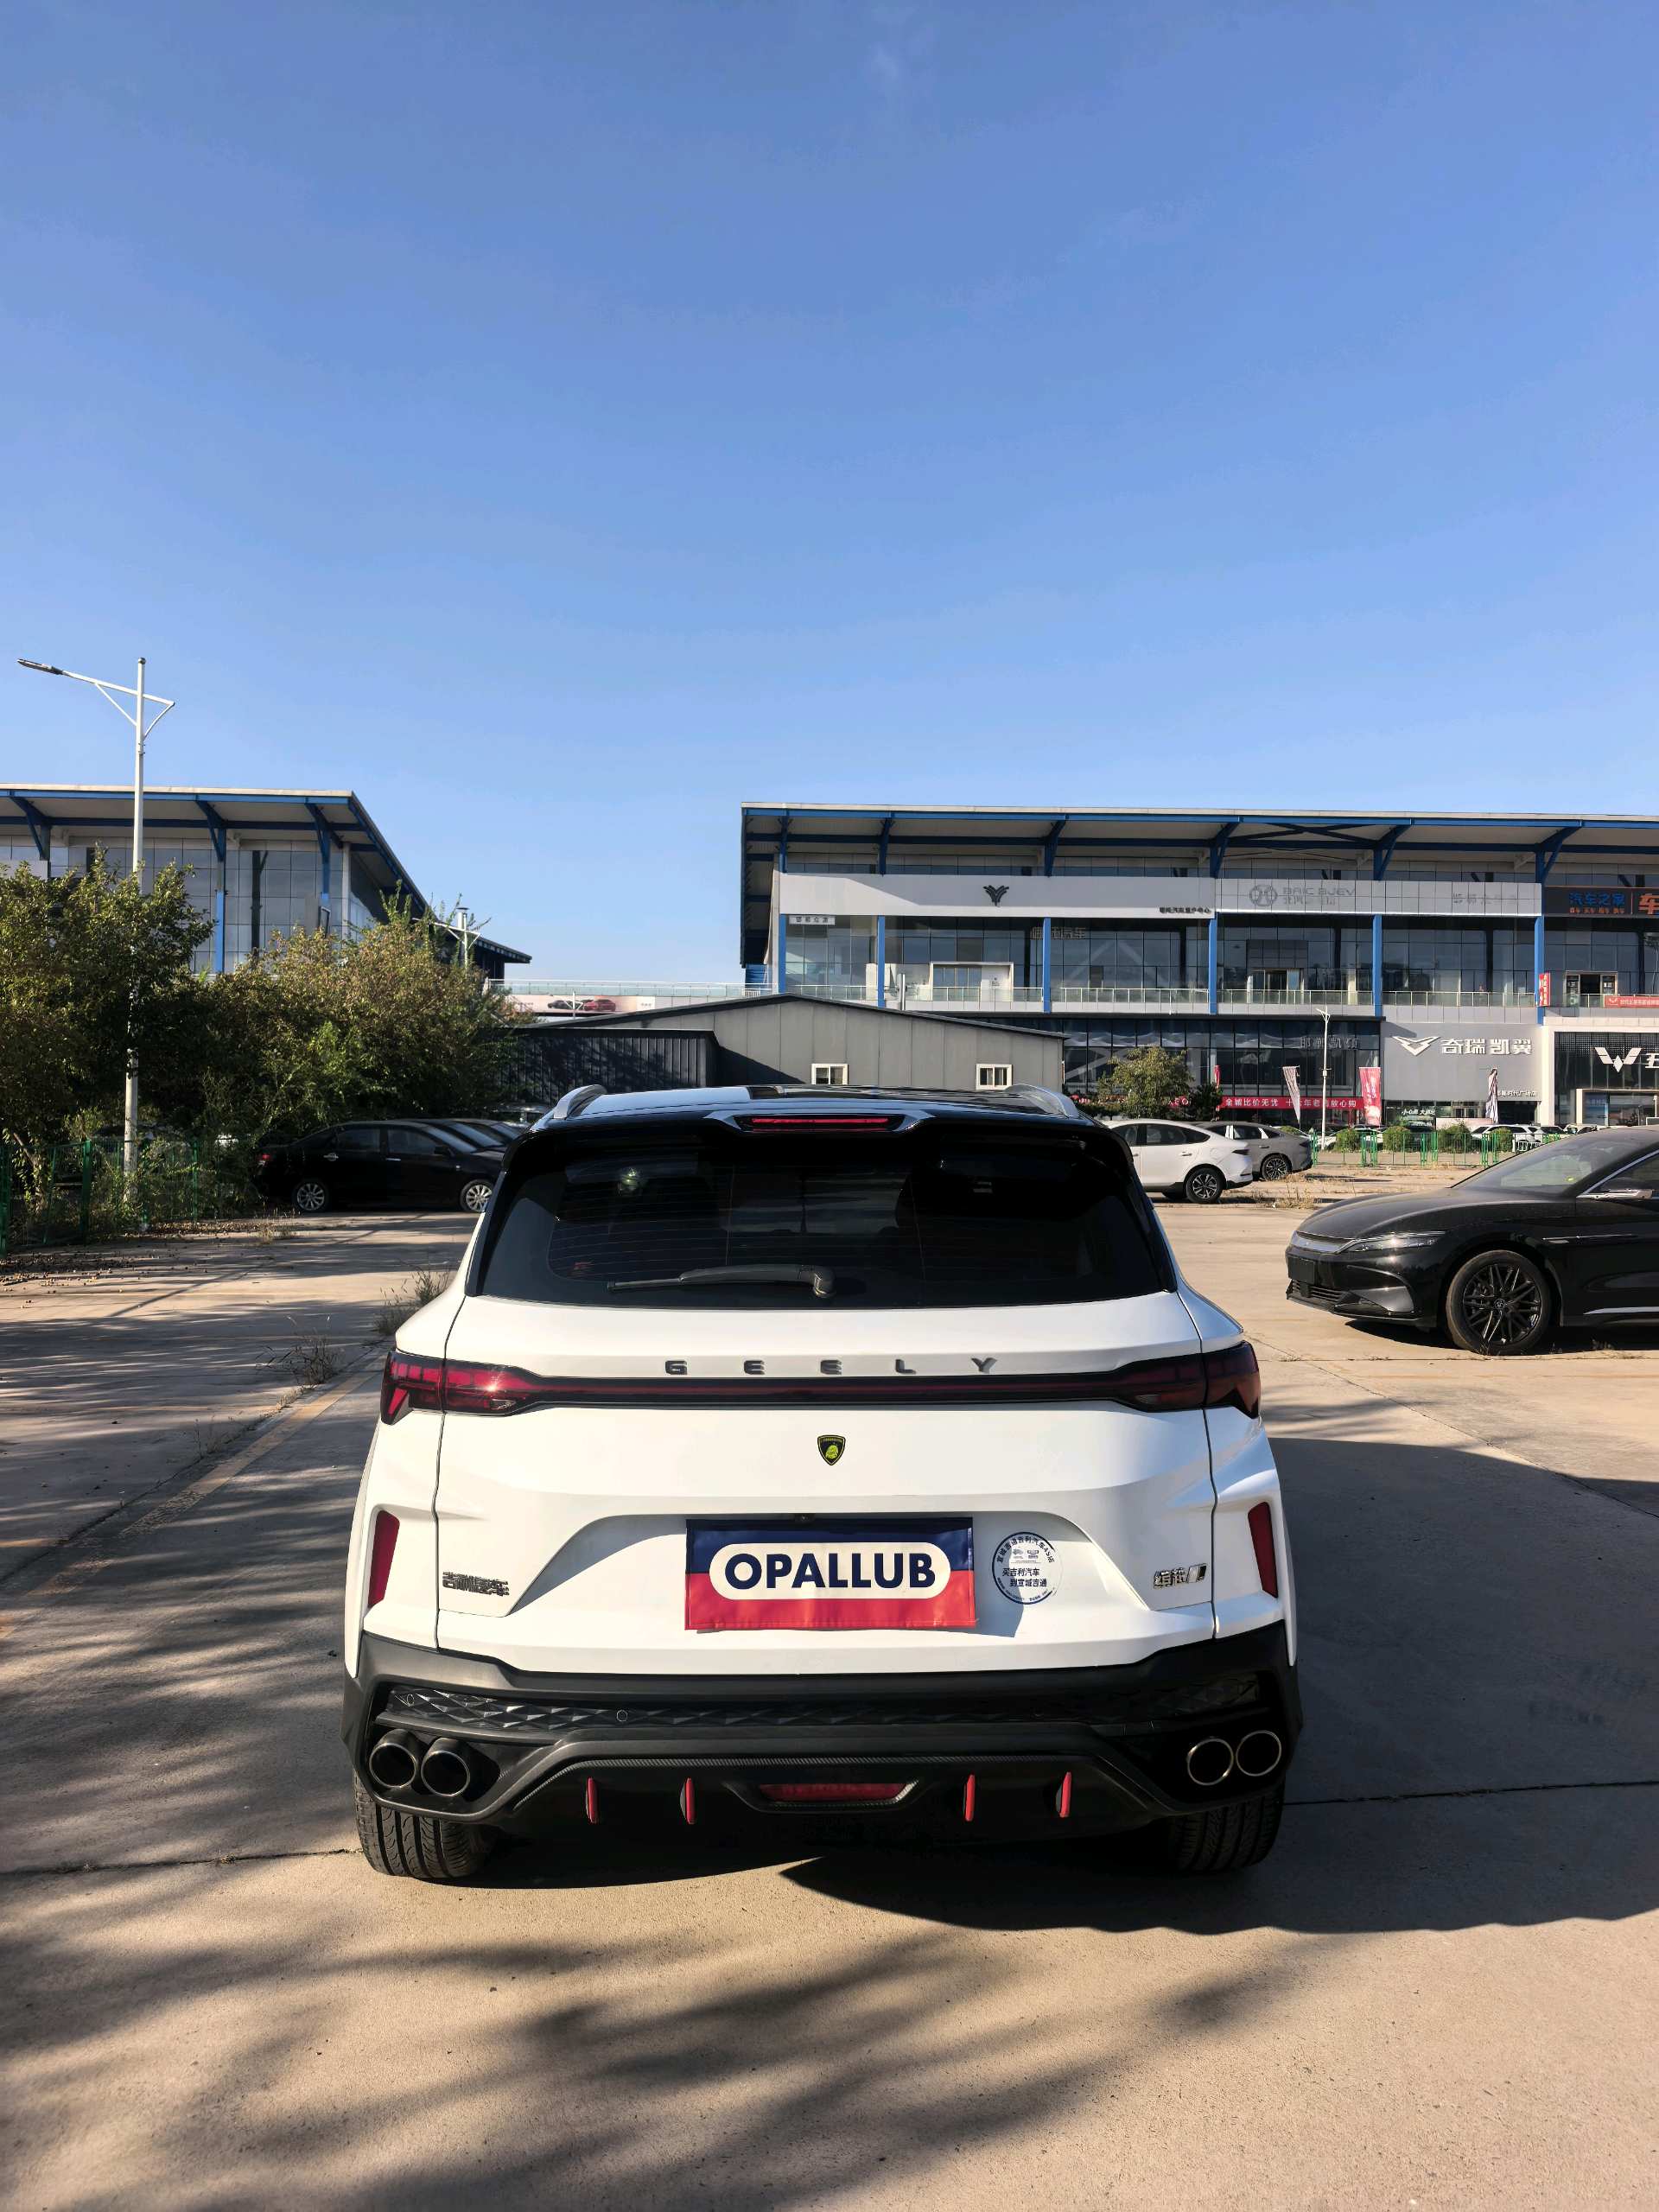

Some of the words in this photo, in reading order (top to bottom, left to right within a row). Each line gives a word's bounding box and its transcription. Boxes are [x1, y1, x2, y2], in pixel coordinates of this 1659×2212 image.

[1440, 1038, 1533, 1055] 奇瑞凯翼
[1285, 1098, 1357, 1107] 十年老放心购
[664, 1357, 998, 1376] GEELY
[724, 1552, 936, 1590] OPALLUB
[1001, 1567, 1040, 1577] 买吉利汽车
[1009, 1578, 1047, 1587] 到宣城吉通
